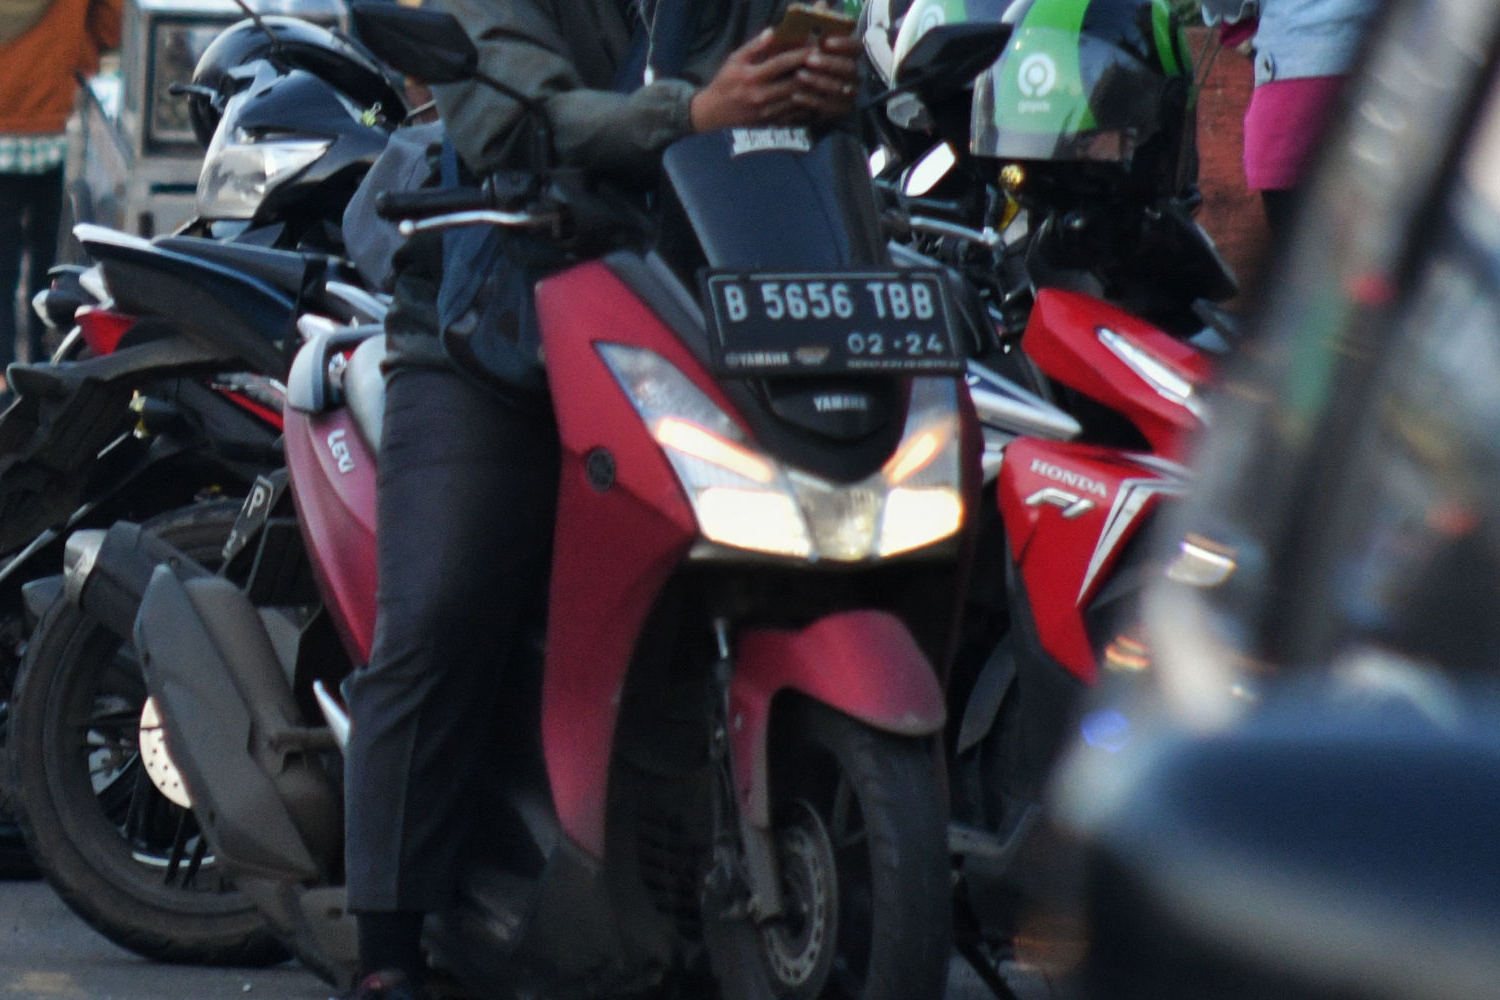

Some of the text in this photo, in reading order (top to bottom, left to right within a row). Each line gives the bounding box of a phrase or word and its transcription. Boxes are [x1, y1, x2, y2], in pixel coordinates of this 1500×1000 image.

[724, 281, 935, 322] B 5656 TBB
[812, 394, 868, 412] YAMAHA
[1029, 458, 1107, 498] HONDA
